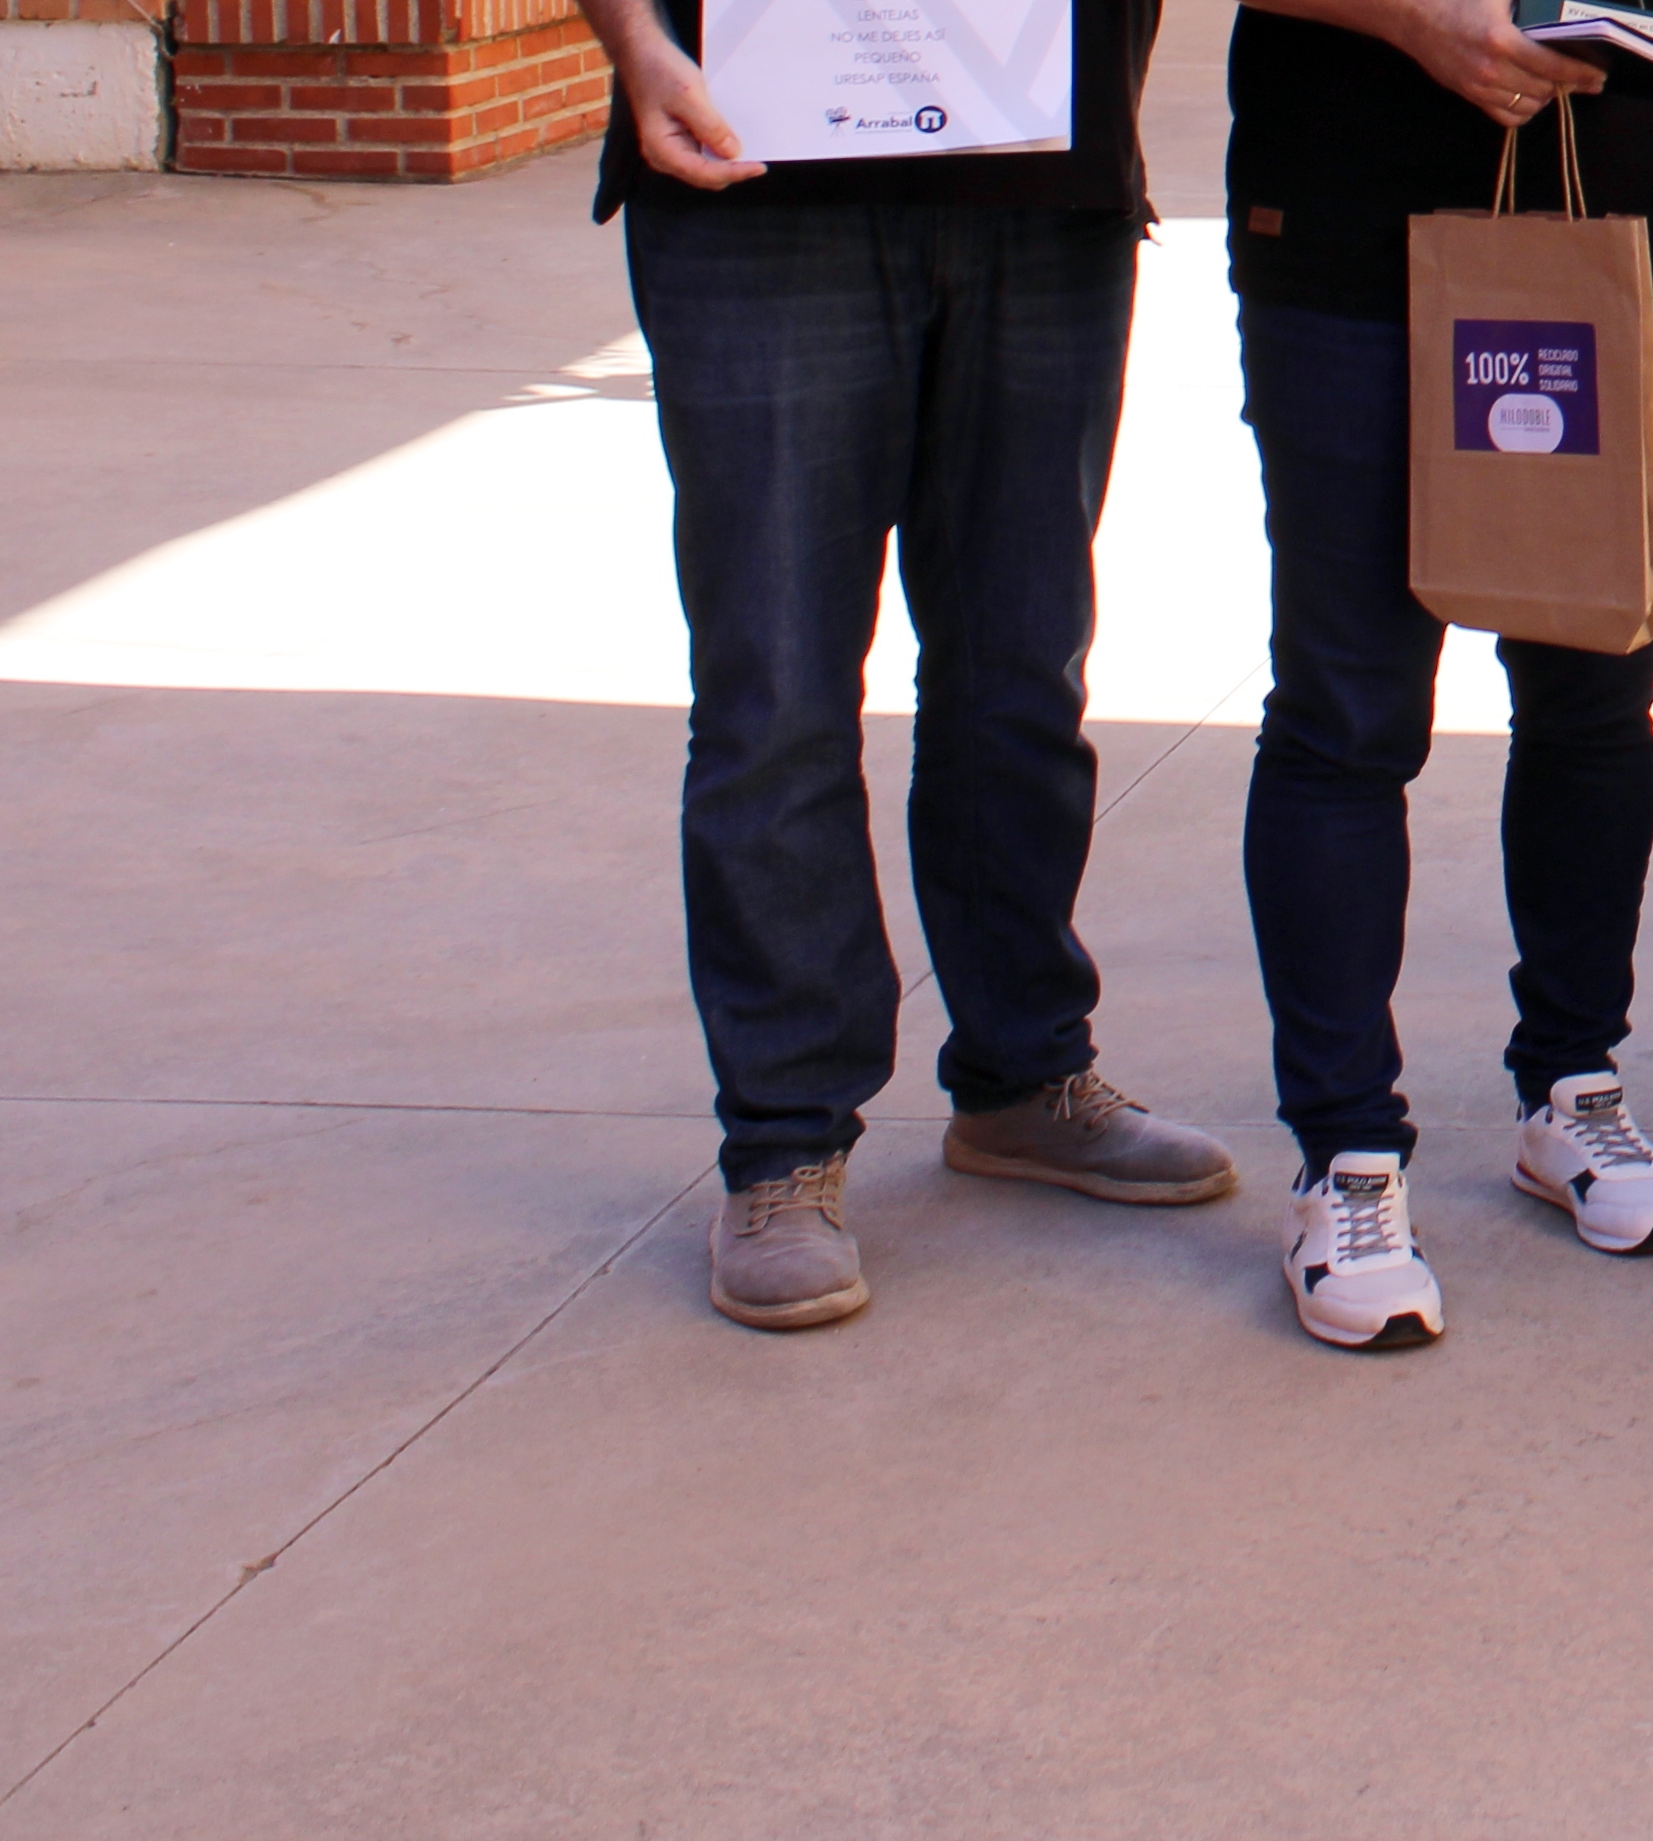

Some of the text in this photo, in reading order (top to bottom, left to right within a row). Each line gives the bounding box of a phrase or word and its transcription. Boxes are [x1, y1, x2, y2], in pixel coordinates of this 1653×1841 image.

[831, 31, 853, 43] NO
[856, 115, 913, 129] Arrabal
[1465, 351, 1530, 386] 100%
